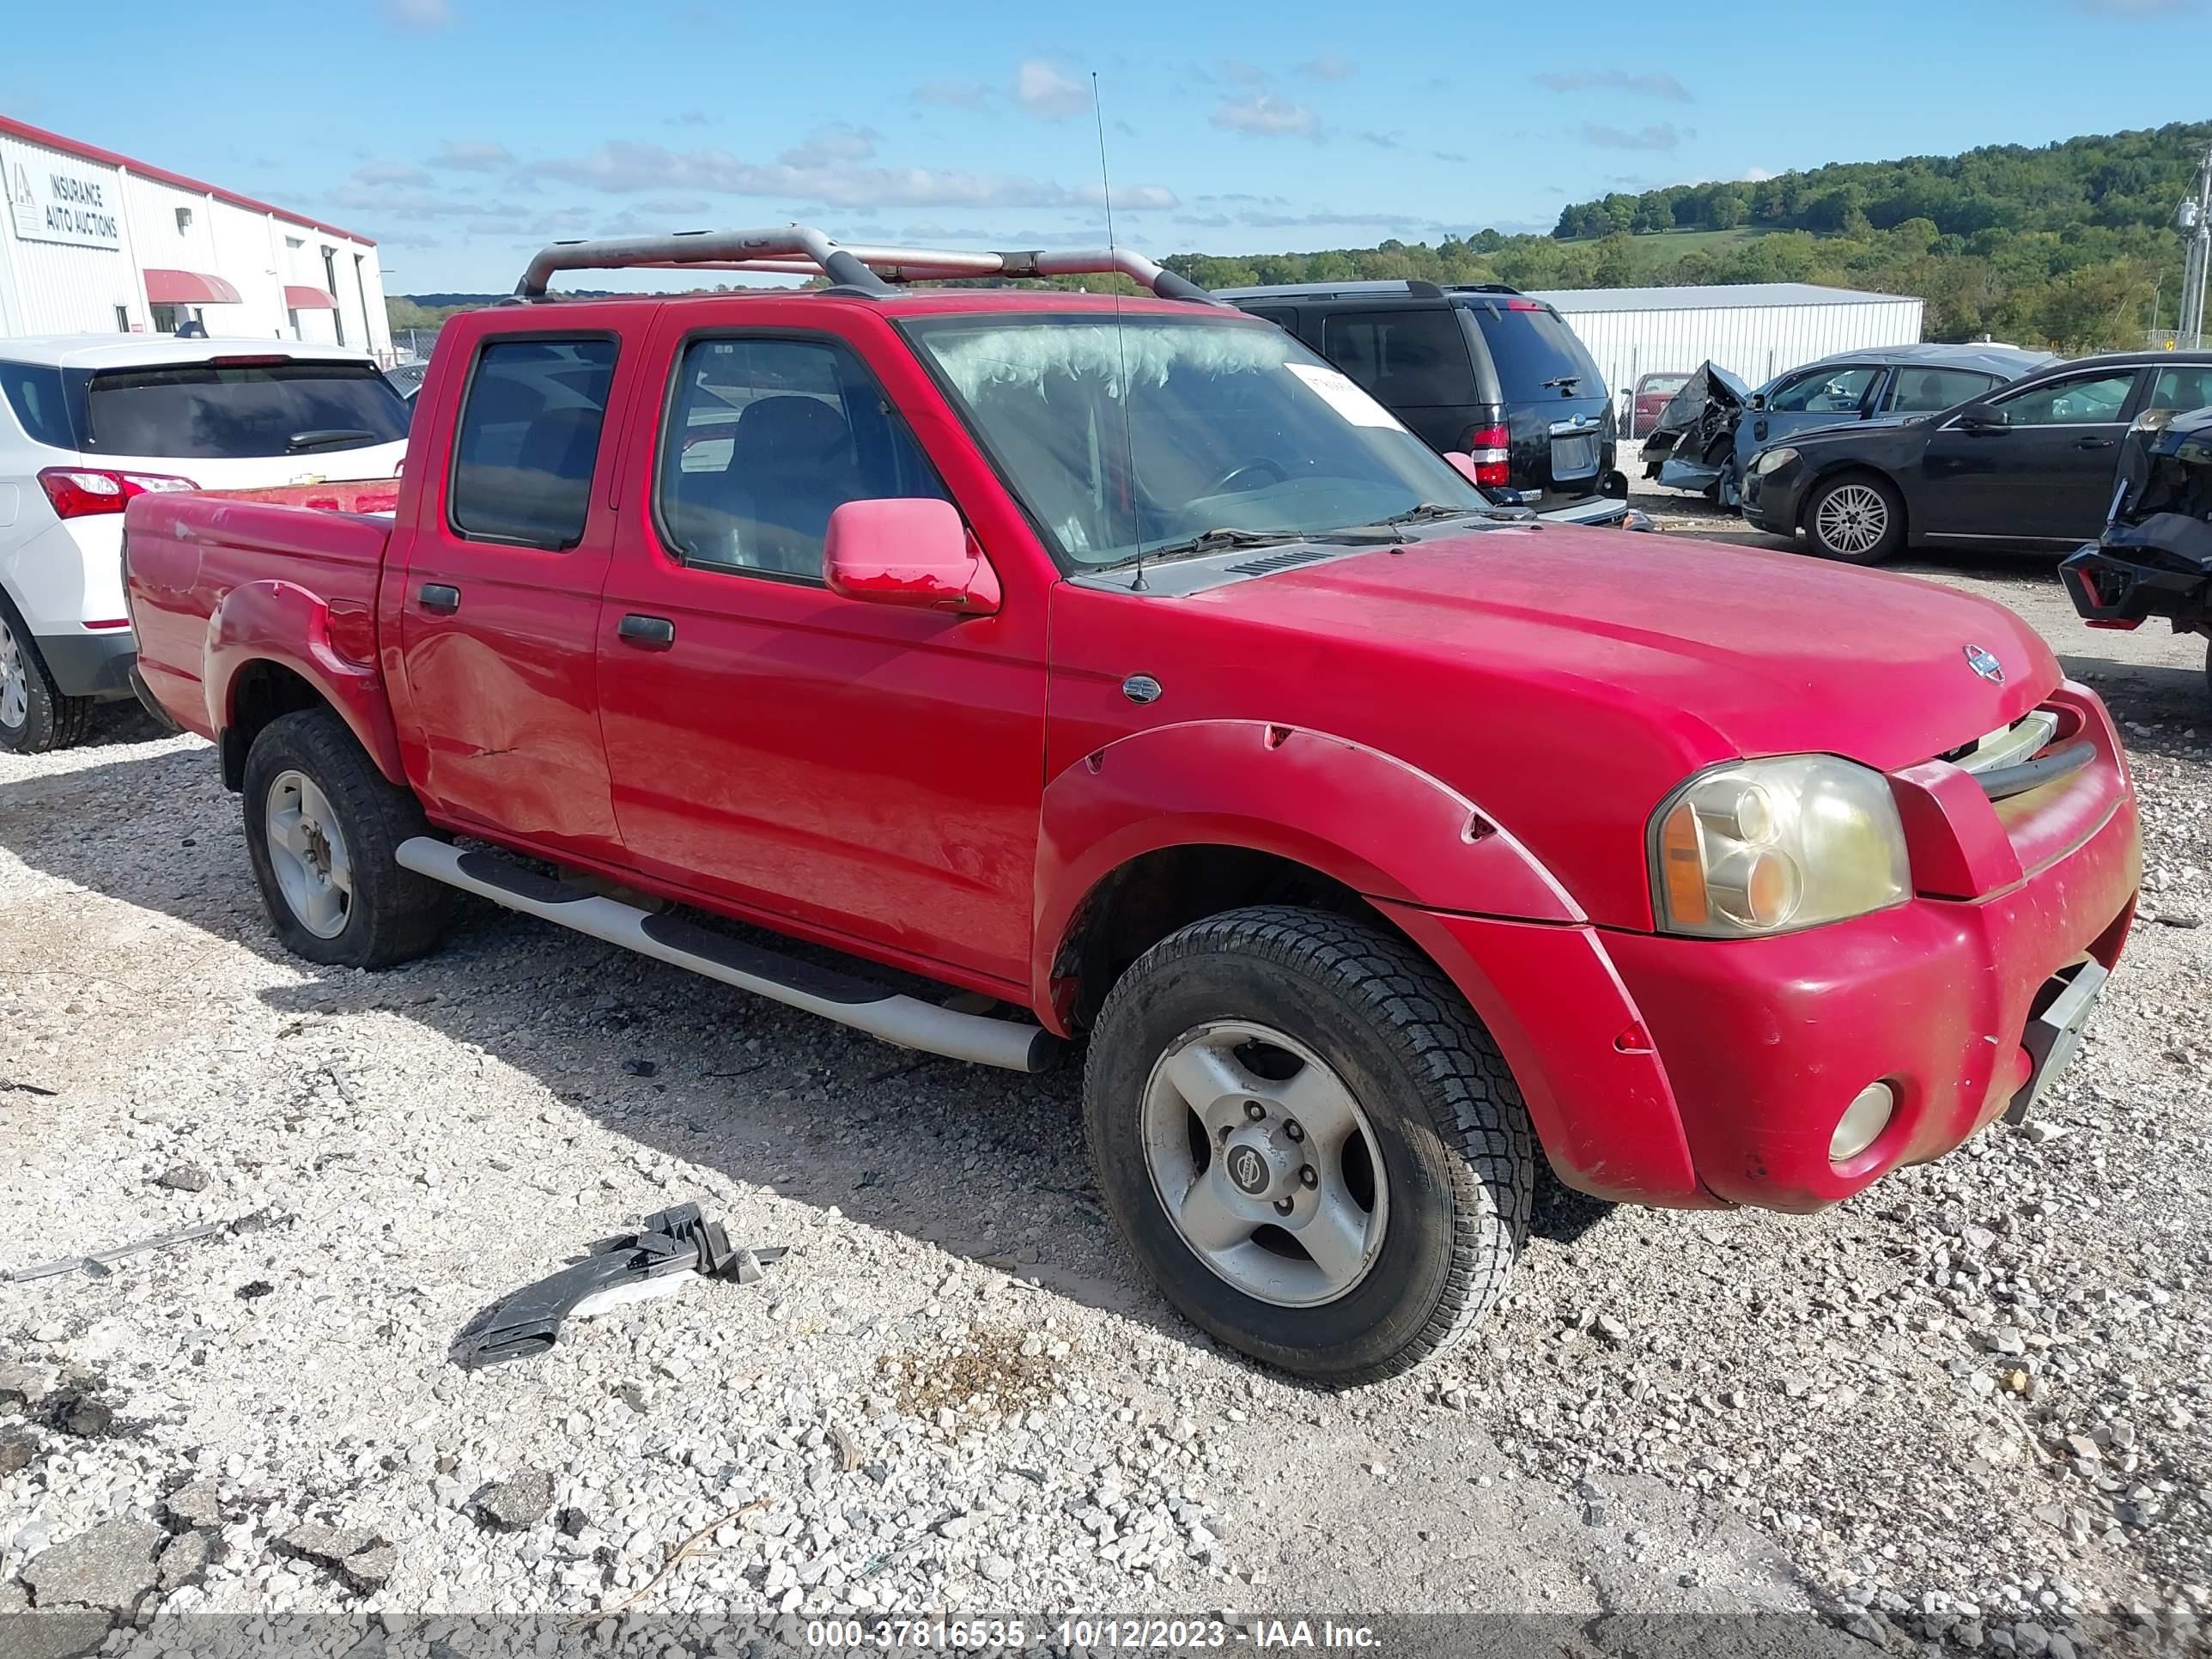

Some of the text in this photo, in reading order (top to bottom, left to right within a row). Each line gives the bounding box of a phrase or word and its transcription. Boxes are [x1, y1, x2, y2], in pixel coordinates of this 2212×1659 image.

[49, 173, 103, 208] INSURANCE
[46, 204, 118, 239] AUTO AUCTIONS
[1243, 1154, 1254, 1185] NISSAN
